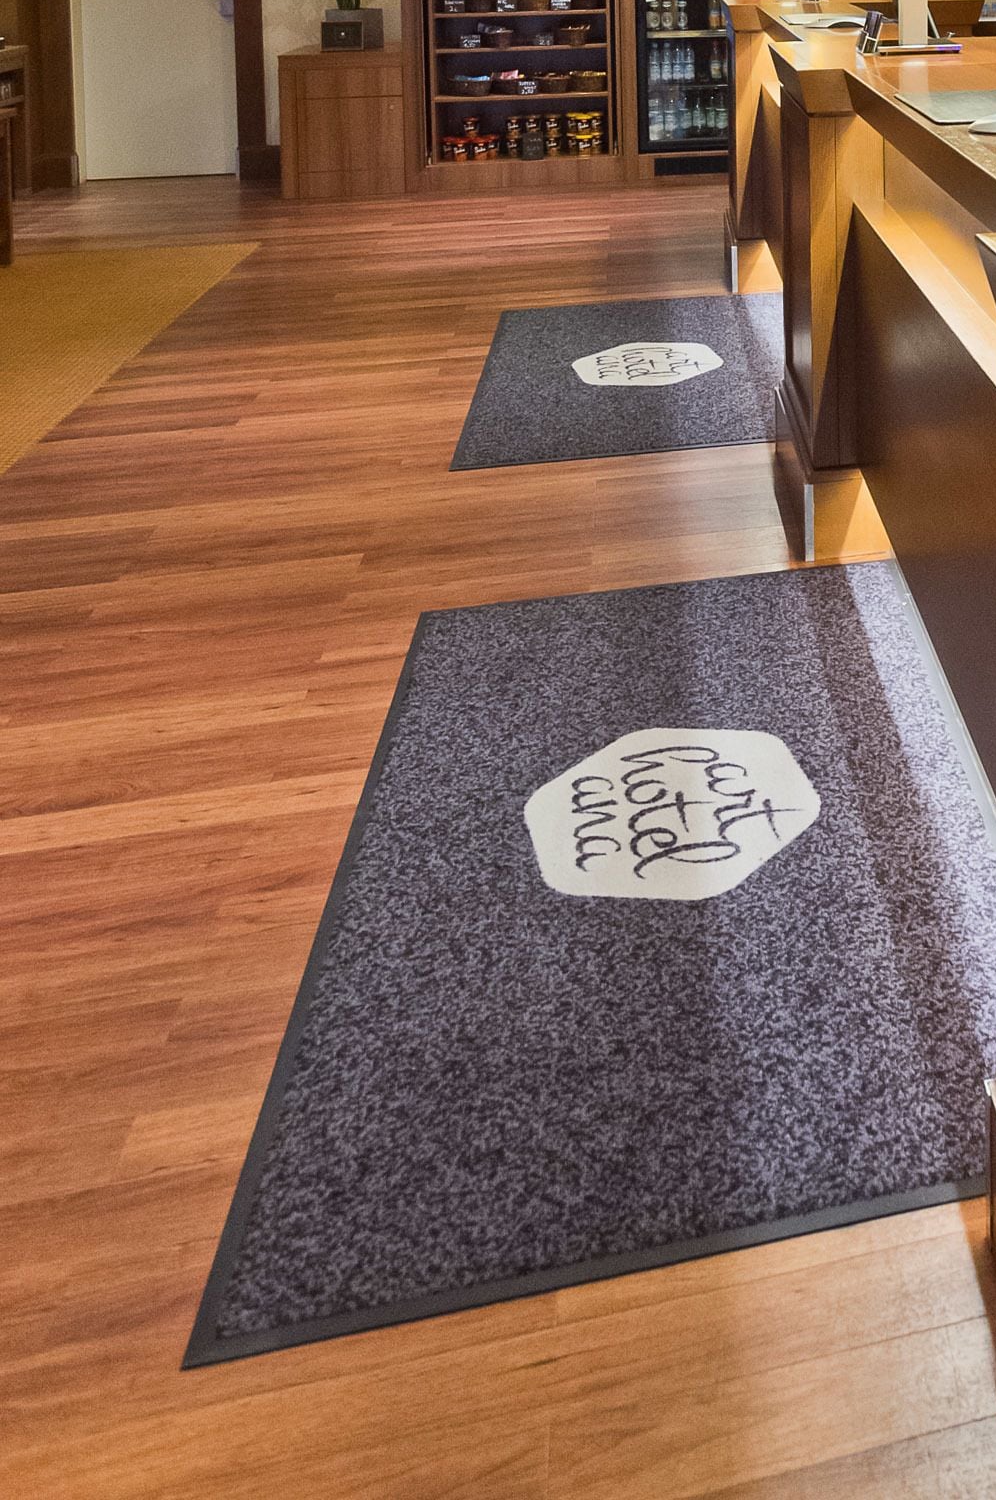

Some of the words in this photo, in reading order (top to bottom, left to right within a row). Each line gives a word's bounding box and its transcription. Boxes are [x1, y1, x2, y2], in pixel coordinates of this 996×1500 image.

[571, 775, 622, 872] ana
[619, 745, 741, 879] hotel
[703, 762, 806, 842] art
